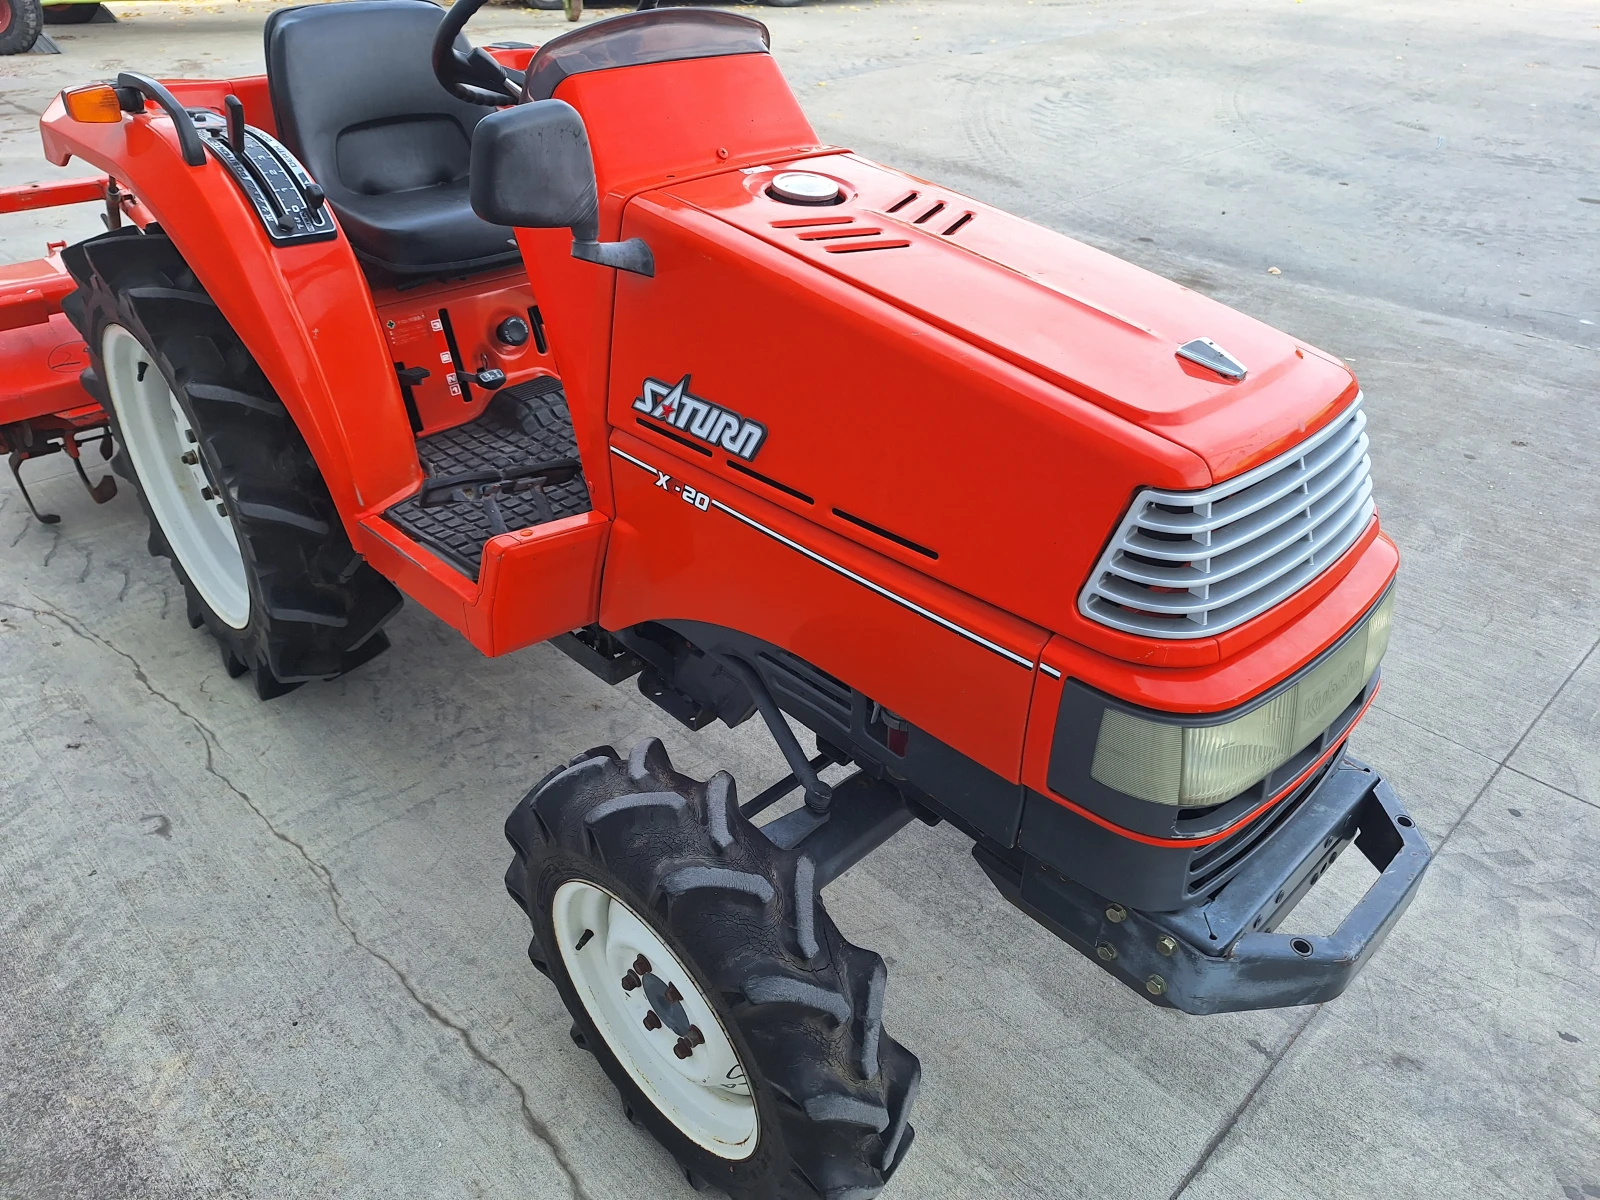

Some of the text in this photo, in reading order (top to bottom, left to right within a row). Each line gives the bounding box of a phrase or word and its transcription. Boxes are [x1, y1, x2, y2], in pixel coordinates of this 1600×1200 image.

[274, 145, 298, 169] DEPTH
[268, 169, 278, 177] 2
[291, 204, 301, 213] 0
[631, 374, 768, 462] SATURN
[1304, 660, 1360, 719] Kubota
